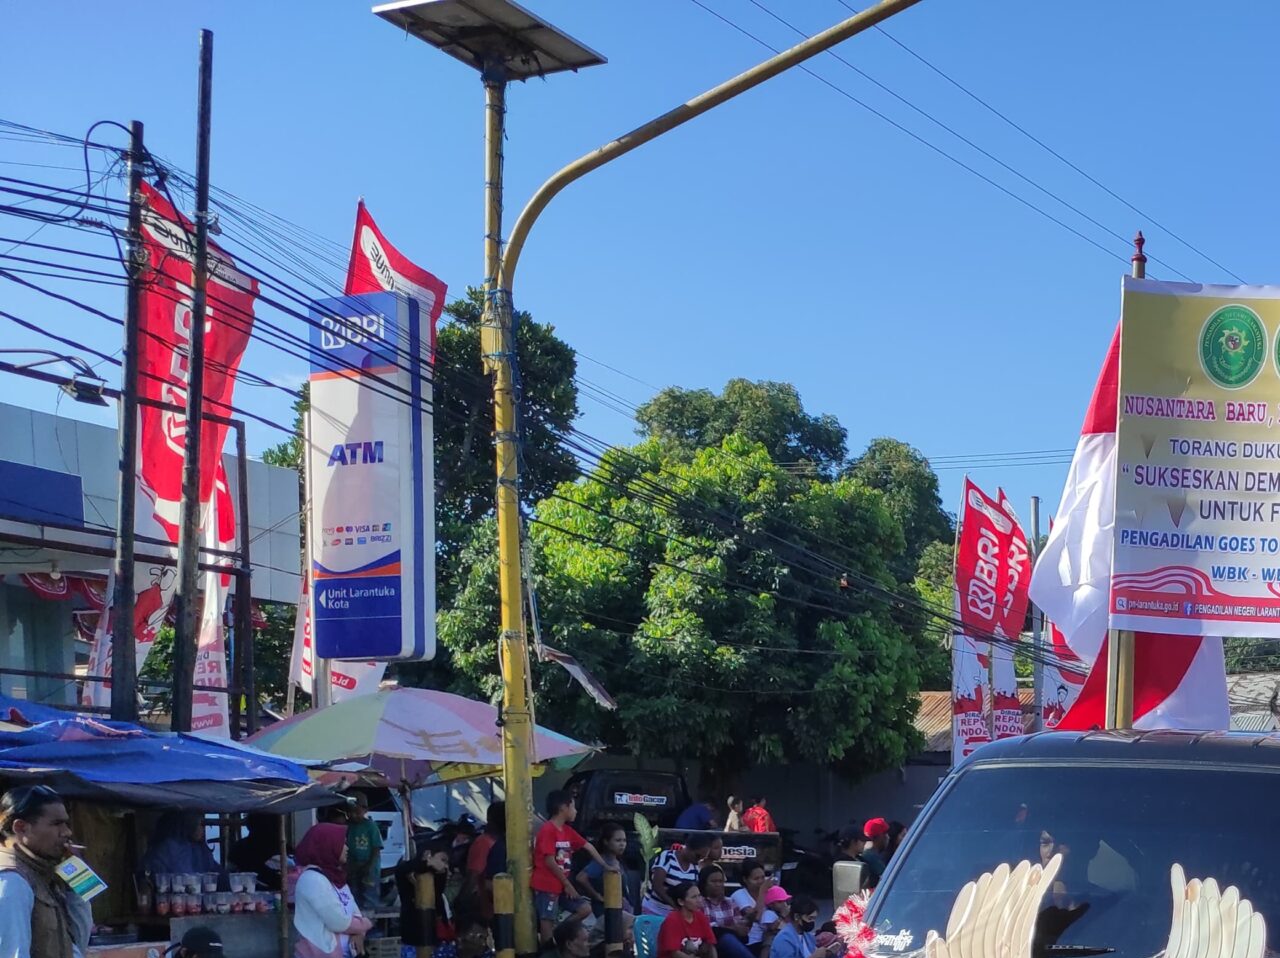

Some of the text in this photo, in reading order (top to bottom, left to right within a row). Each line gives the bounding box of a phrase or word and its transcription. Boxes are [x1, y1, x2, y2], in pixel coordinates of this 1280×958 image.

[1125, 396, 1216, 421] NUSANTARA
[327, 441, 384, 466] ATM
[1169, 438, 1238, 459] TORANG
[1133, 465, 1240, 491] SUKSESKAN
[1199, 500, 1264, 522] UNTUK
[354, 525, 370, 533] VISA
[1120, 529, 1214, 550] PENGADILAN
[1218, 535, 1255, 553] GOES
[1259, 537, 1278, 553] TO
[974, 527, 1000, 589] BRI
[1211, 565, 1249, 581] WBK
[327, 586, 395, 599] Unit Larantuka
[327, 599, 350, 609] Kota
[1194, 604, 1233, 615] PENGADILAN
[1233, 606, 1256, 616] NEGERI
